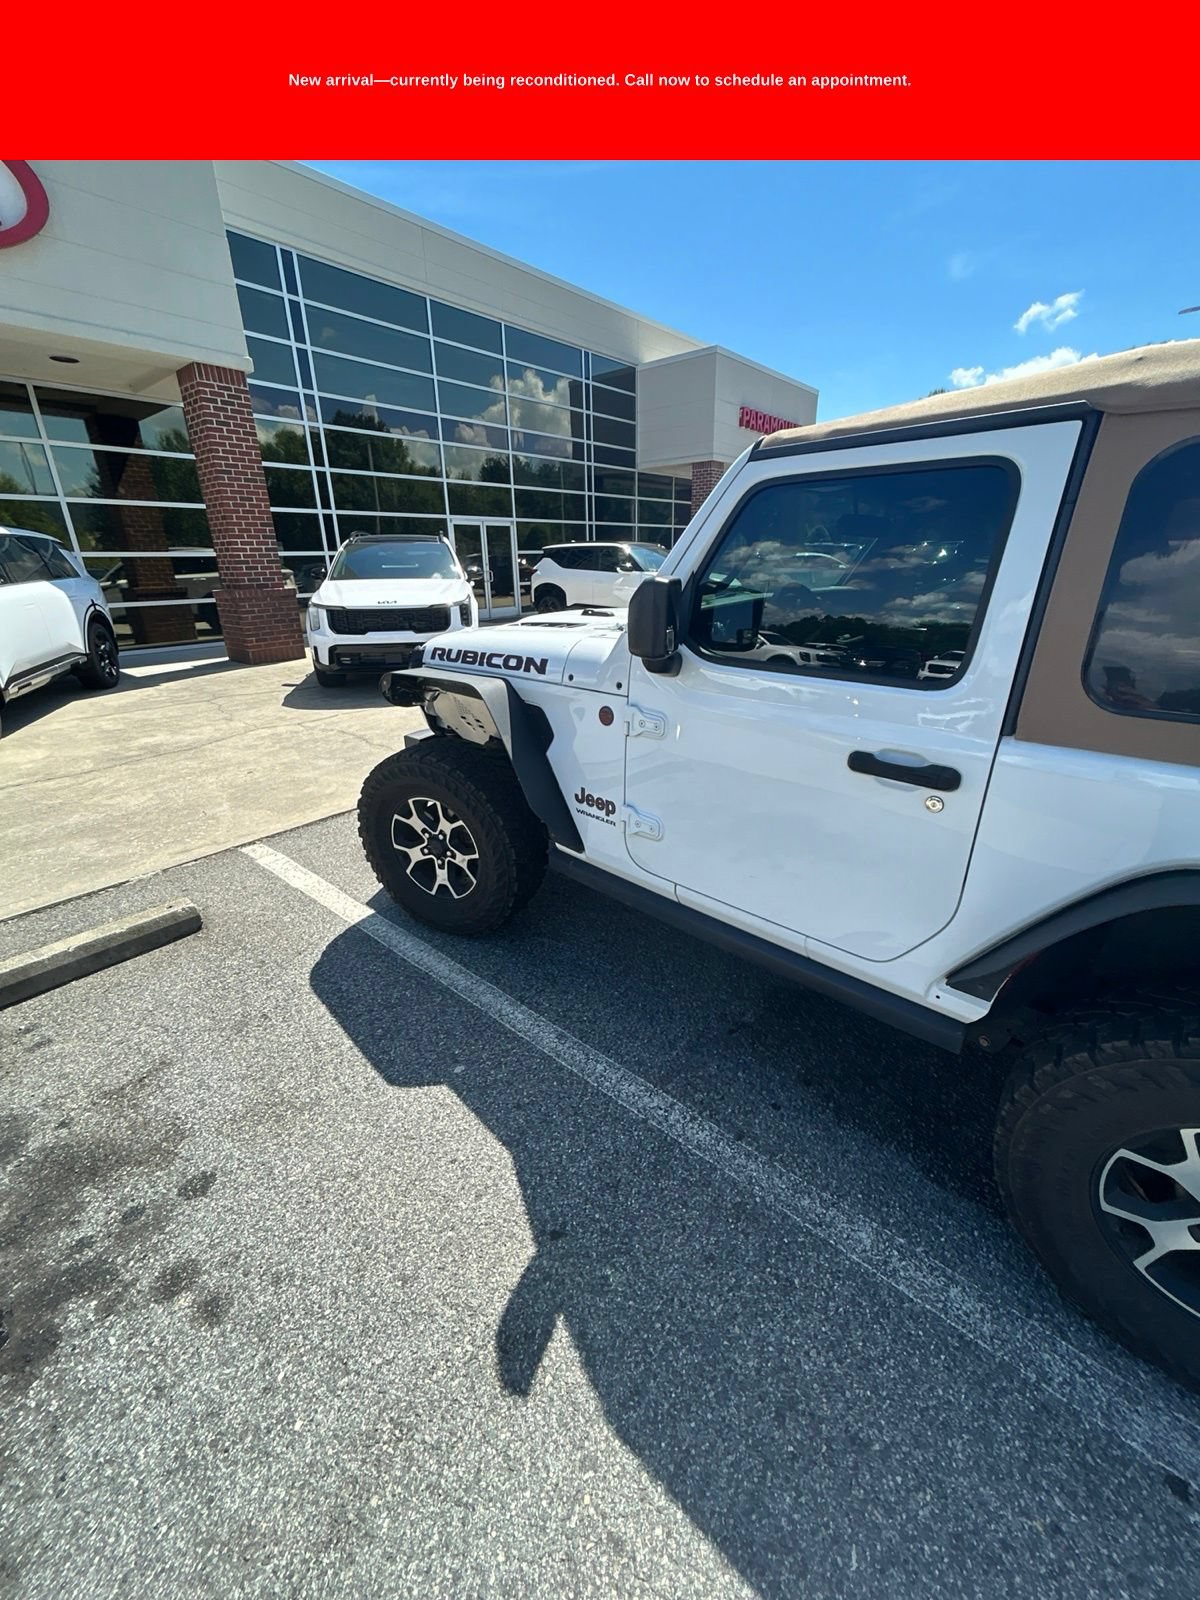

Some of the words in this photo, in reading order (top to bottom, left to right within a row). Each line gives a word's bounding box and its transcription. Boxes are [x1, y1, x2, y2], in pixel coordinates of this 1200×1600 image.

[430, 647, 549, 675] RUBICON
[574, 786, 617, 817] Jeep
[575, 807, 617, 827] WRANGLER
